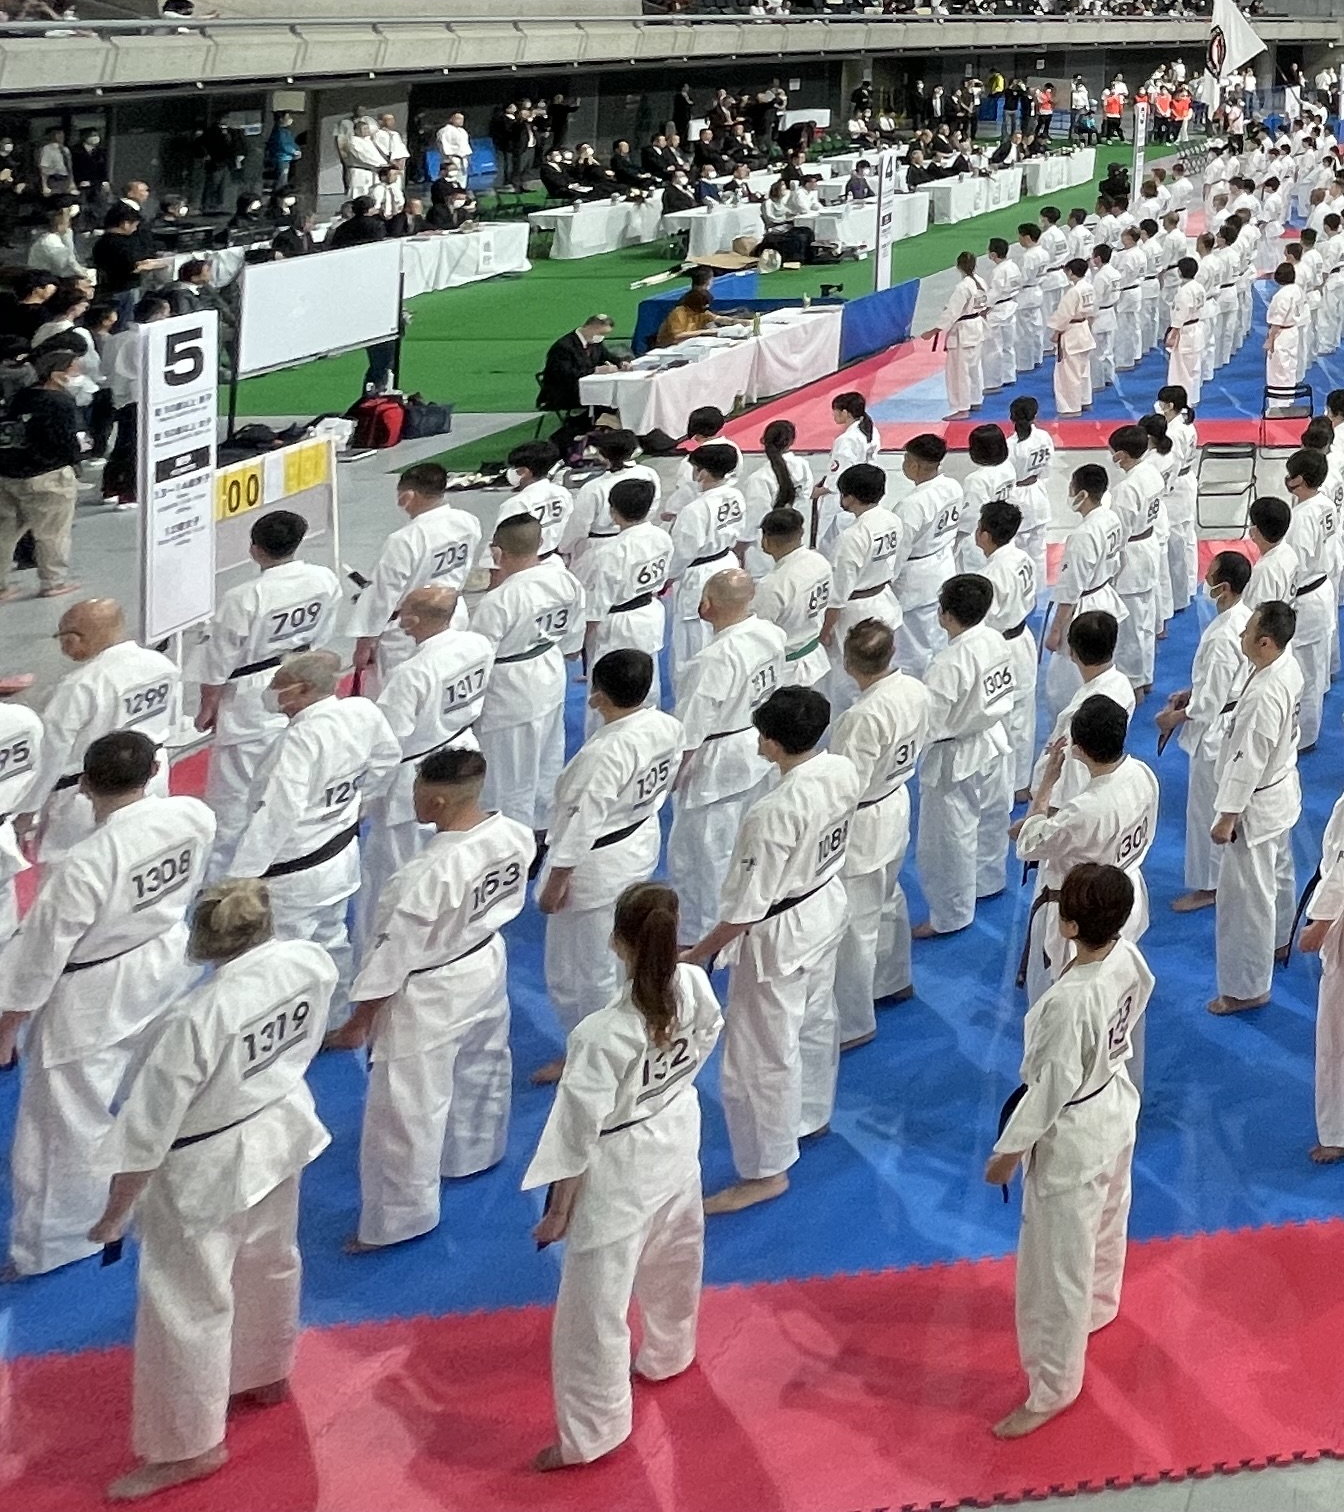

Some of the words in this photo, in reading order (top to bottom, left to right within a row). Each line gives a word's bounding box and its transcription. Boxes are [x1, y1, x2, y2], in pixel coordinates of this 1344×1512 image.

[163, 327, 205, 387] 5
[272, 601, 322, 634] 709
[124, 683, 169, 715] 1299
[447, 668, 485, 703] 1317
[983, 666, 1012, 697] 1306
[132, 849, 191, 899] 1308
[242, 1001, 309, 1062] 1319
